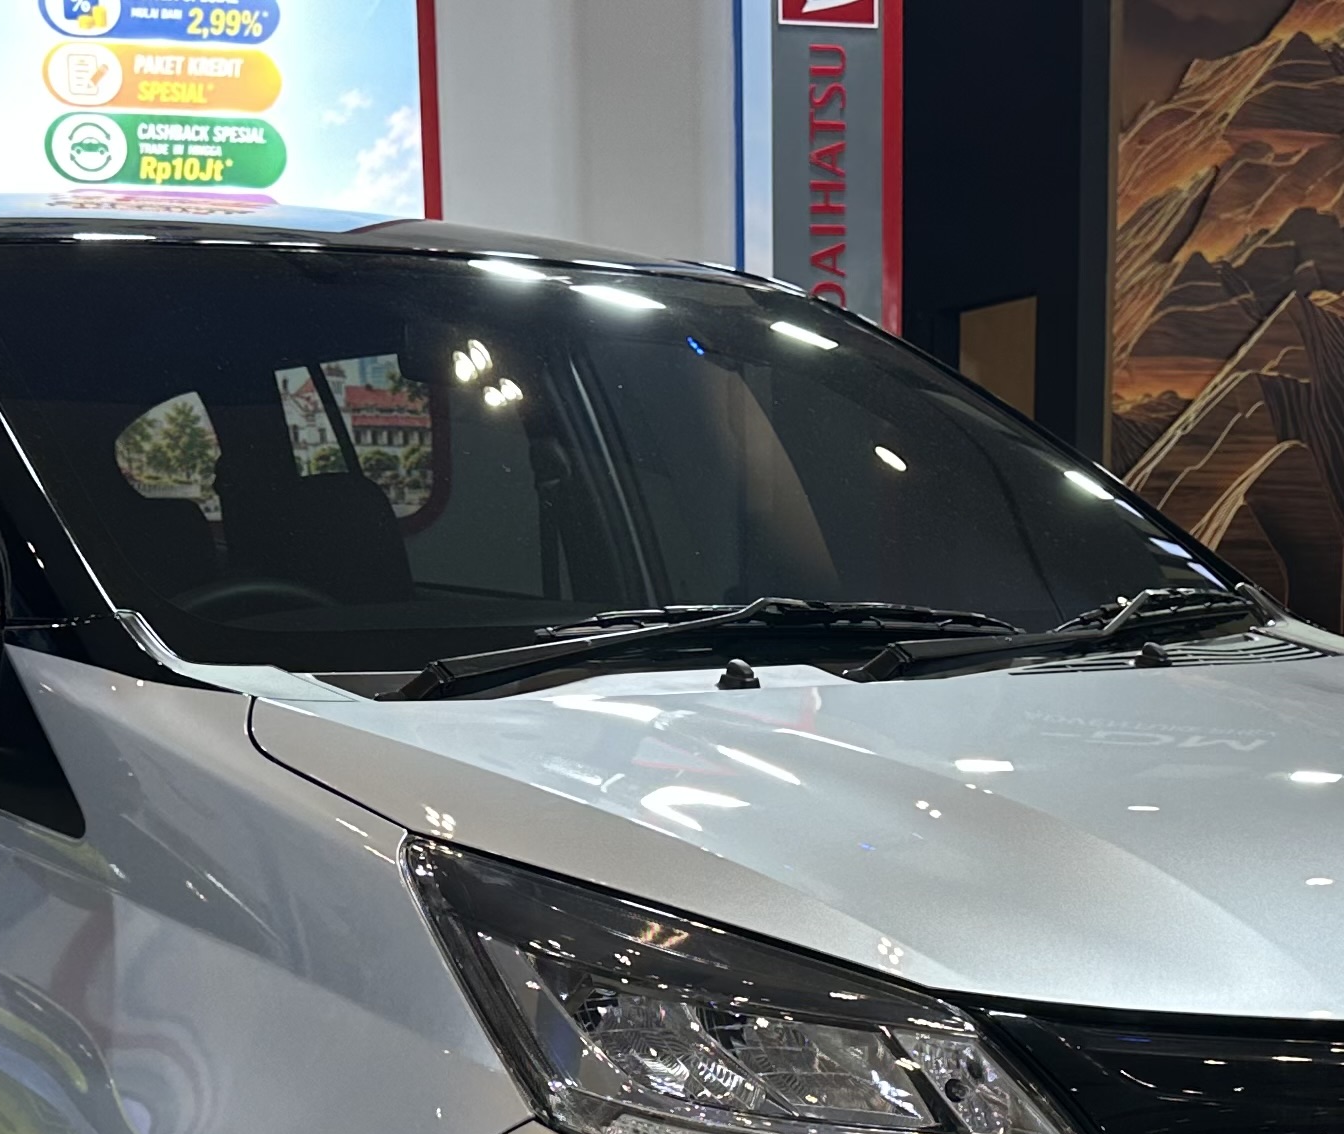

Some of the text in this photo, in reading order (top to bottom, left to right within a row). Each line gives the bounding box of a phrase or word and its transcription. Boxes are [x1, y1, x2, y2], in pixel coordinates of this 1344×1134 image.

[134, 54, 244, 79] PAKET KREDIT
[137, 122, 267, 144] CASHBACK SPESIAL
